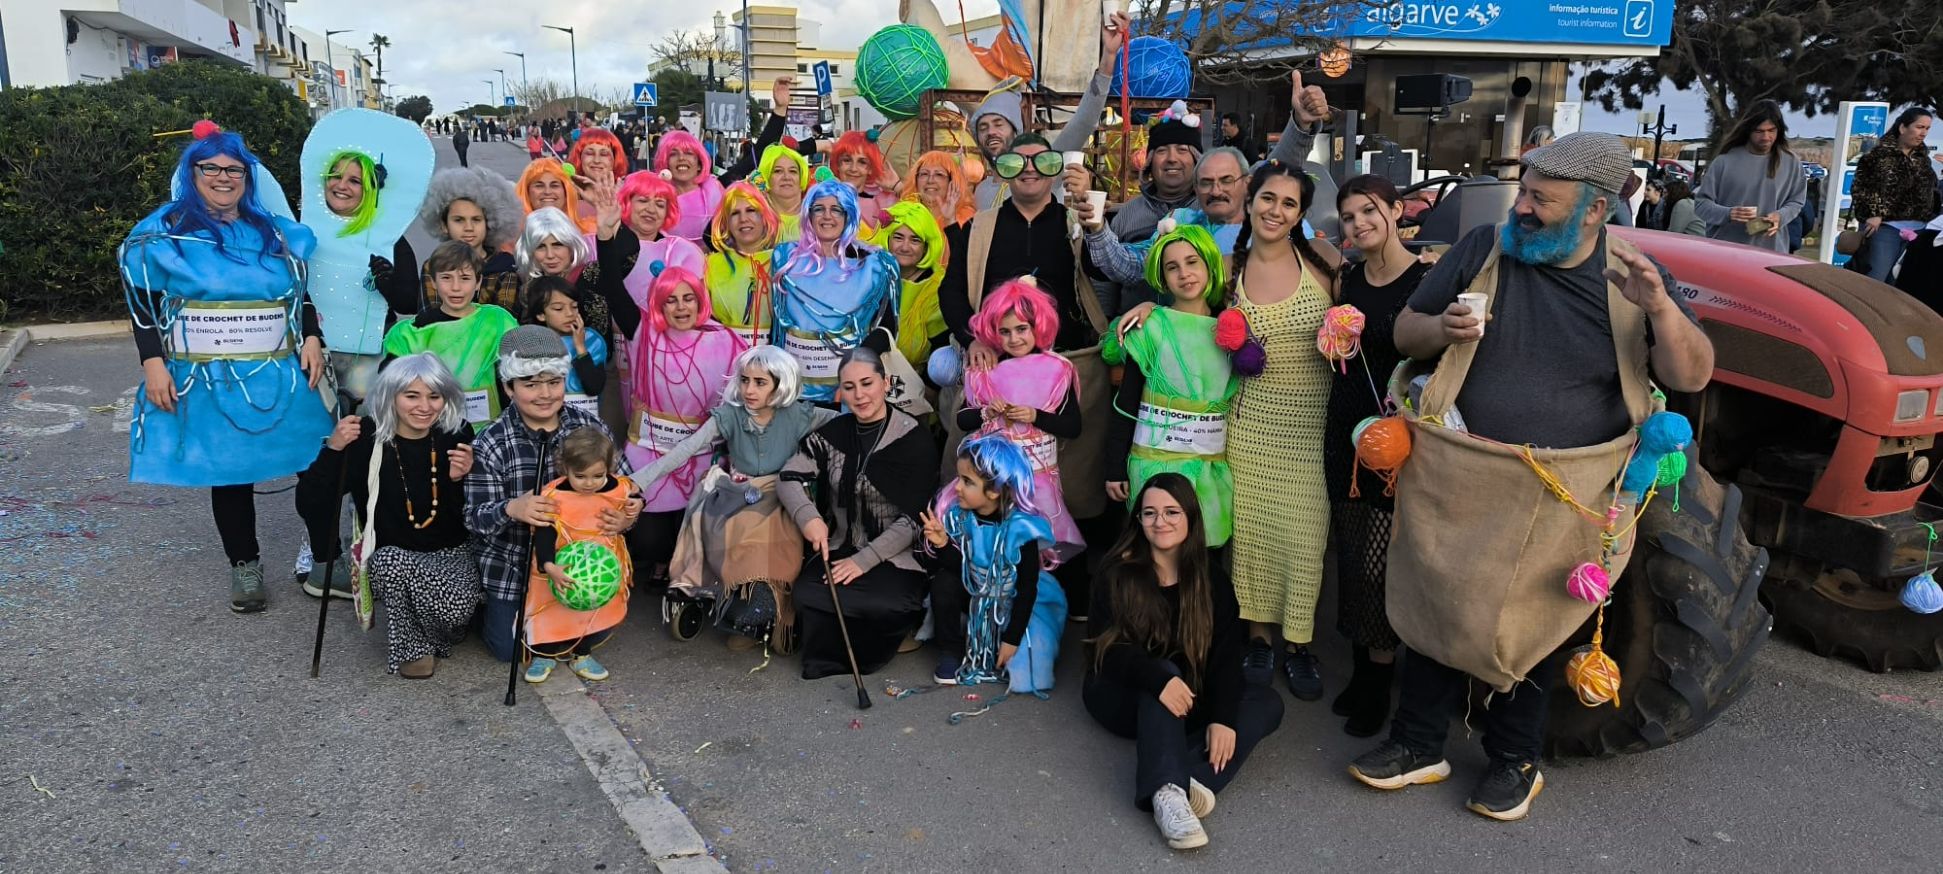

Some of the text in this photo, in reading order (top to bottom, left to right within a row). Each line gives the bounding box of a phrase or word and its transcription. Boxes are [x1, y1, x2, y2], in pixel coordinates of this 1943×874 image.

[1366, 0, 1459, 30] algarve
[1549, 4, 1589, 15] informação
[1558, 18, 1618, 29] tourist information
[816, 65, 827, 94] P
[1677, 285, 1699, 299] 80
[798, 344, 827, 352] CROCHET
[1160, 410, 1197, 422] CROCHET
